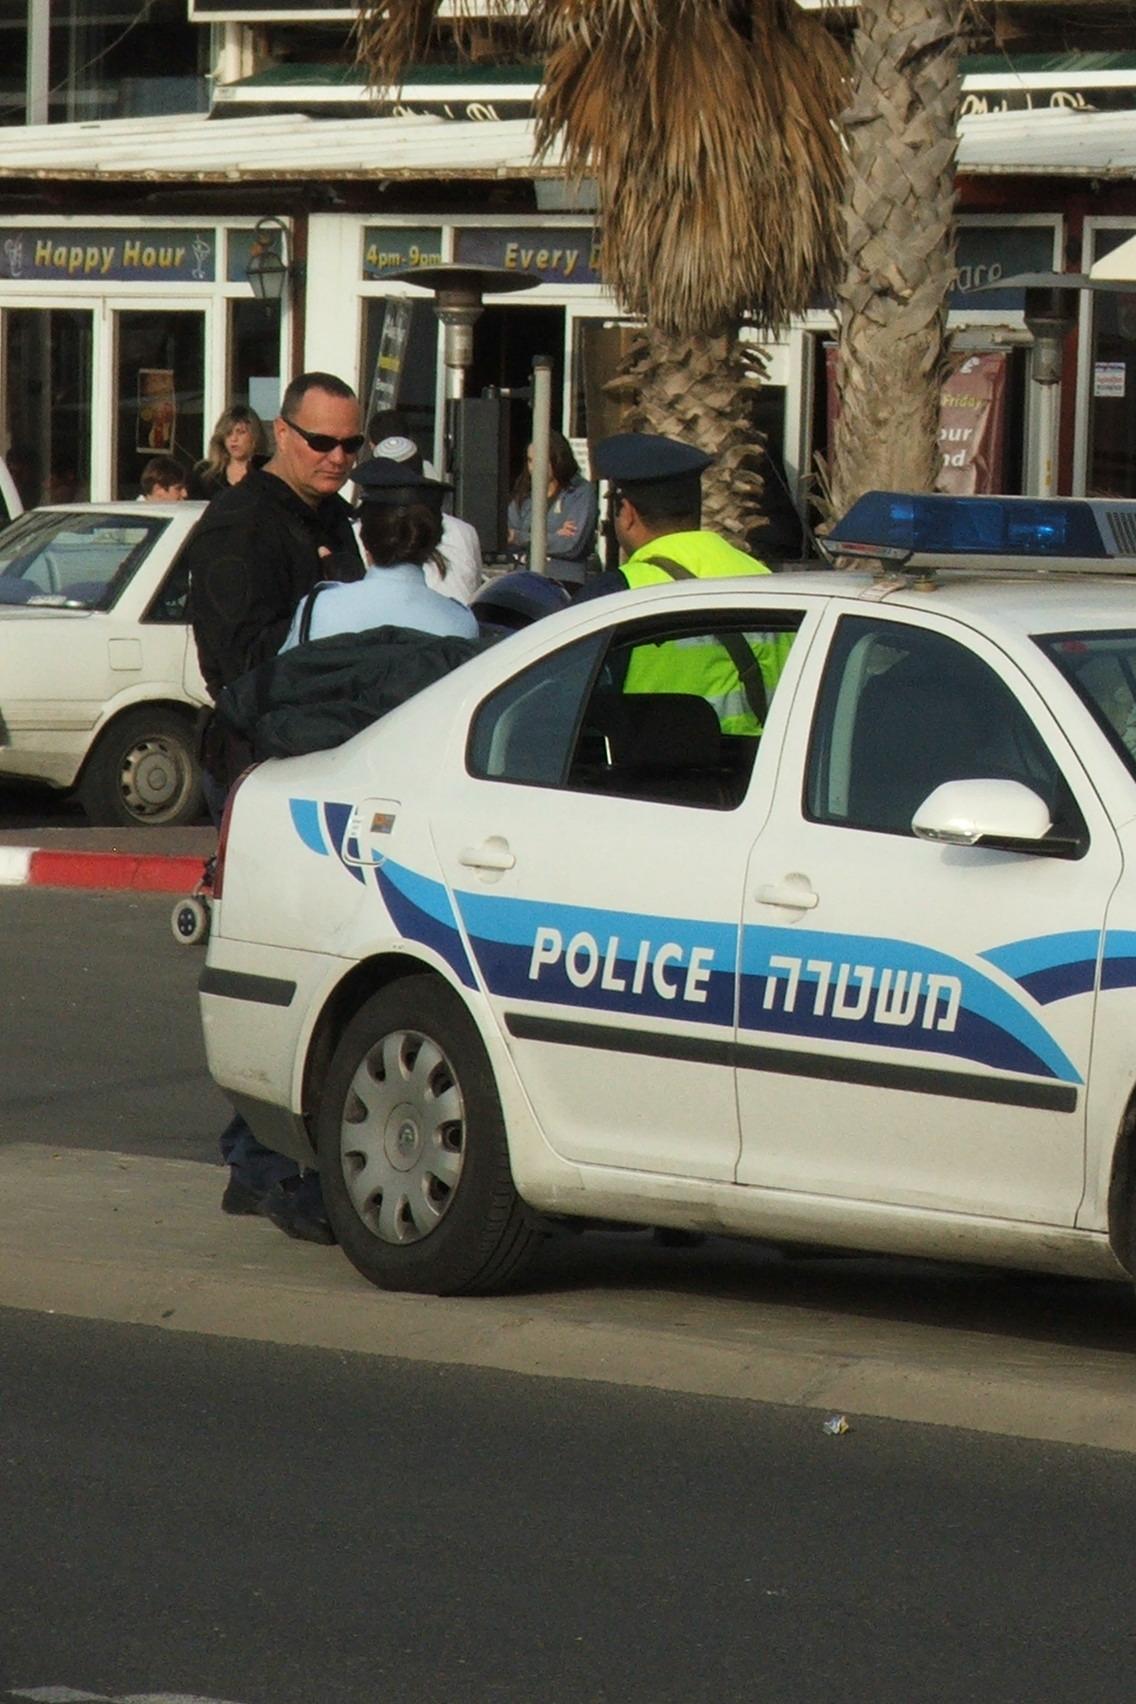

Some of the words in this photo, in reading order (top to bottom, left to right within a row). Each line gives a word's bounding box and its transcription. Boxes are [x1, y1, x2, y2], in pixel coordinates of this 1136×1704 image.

[34, 240, 115, 274] Happy
[123, 240, 186, 268] Hour
[504, 242, 579, 275] Every
[942, 393, 982, 410] Friday
[528, 927, 715, 1003] POLICE
[763, 955, 962, 1032] משטרה
